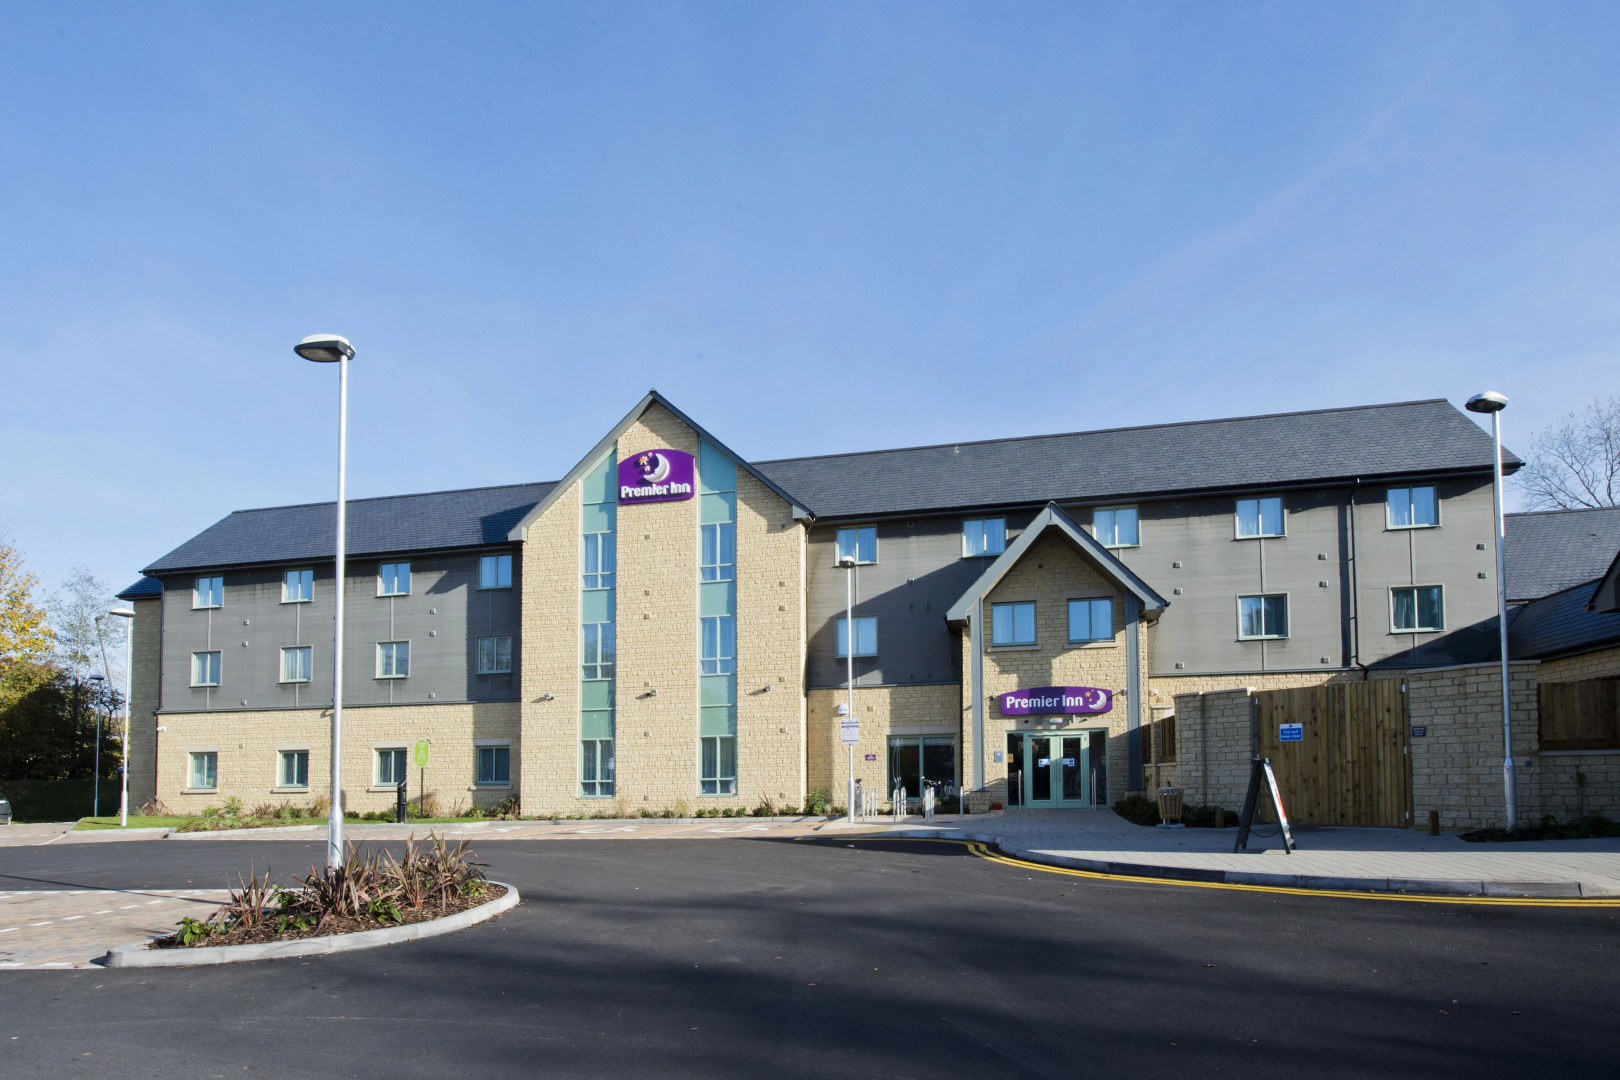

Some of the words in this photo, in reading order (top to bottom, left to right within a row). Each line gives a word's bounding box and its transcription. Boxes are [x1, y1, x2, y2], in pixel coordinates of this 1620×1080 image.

[621, 483, 669, 498] Premier
[670, 481, 691, 494] Inn
[1006, 695, 1060, 709] Premier
[1062, 694, 1083, 707] Inn
